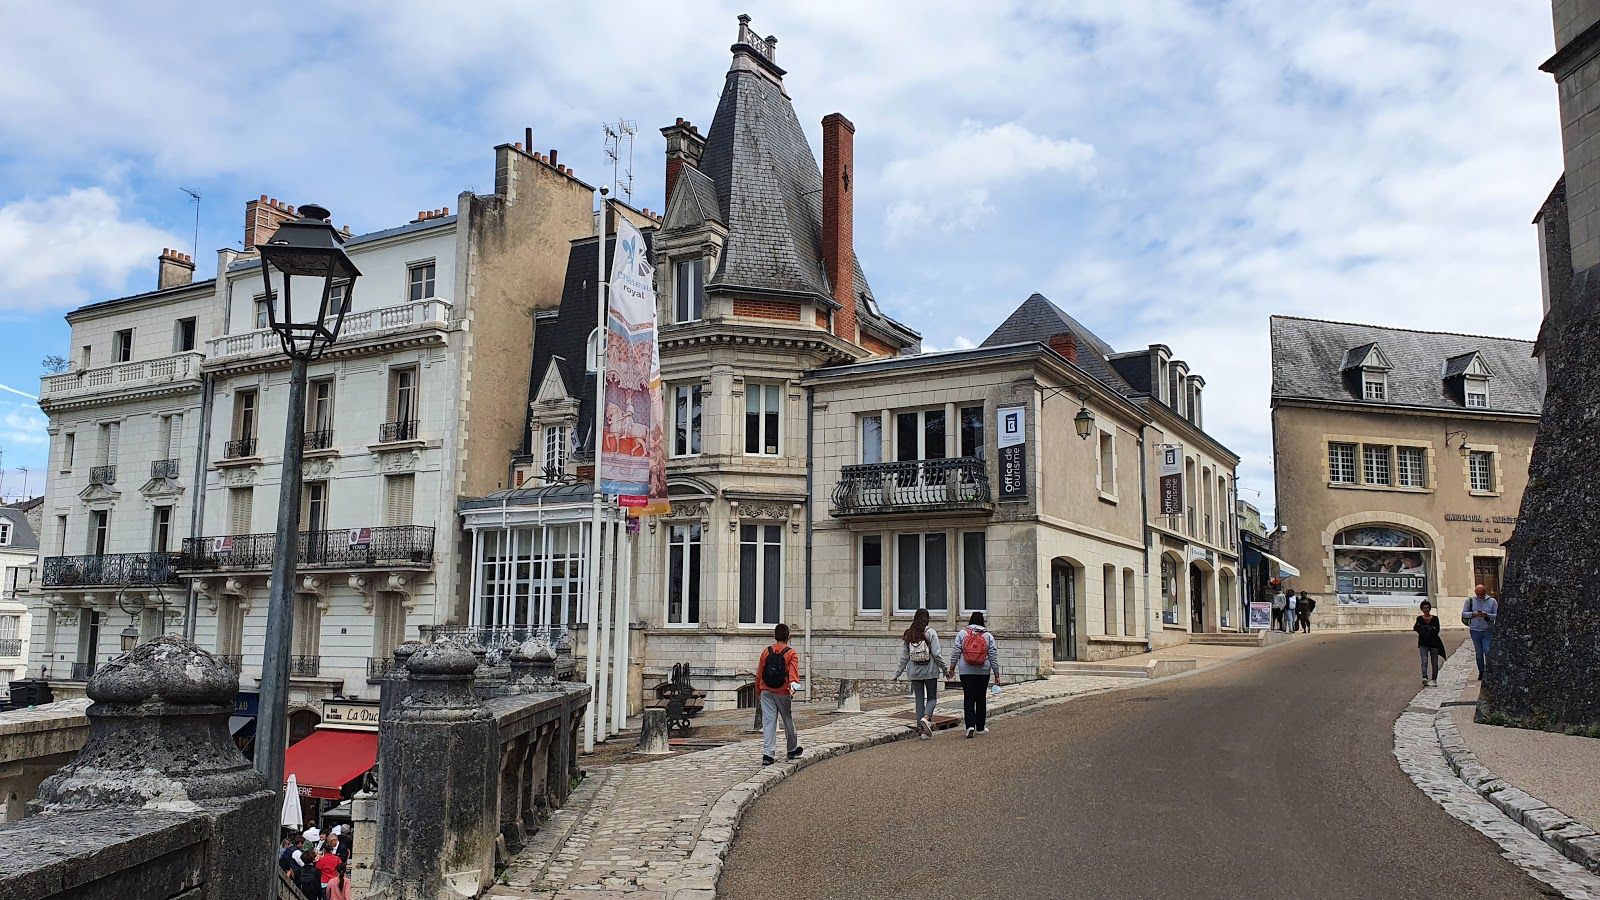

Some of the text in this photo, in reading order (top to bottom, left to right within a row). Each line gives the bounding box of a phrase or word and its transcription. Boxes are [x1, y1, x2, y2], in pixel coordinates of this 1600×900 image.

[623, 285, 645, 300] royal
[1005, 448, 1013, 461] de
[1013, 447, 1021, 493] Tourisme
[1005, 462, 1013, 493] Office
[1165, 478, 1172, 490] de
[347, 708, 359, 721] La
